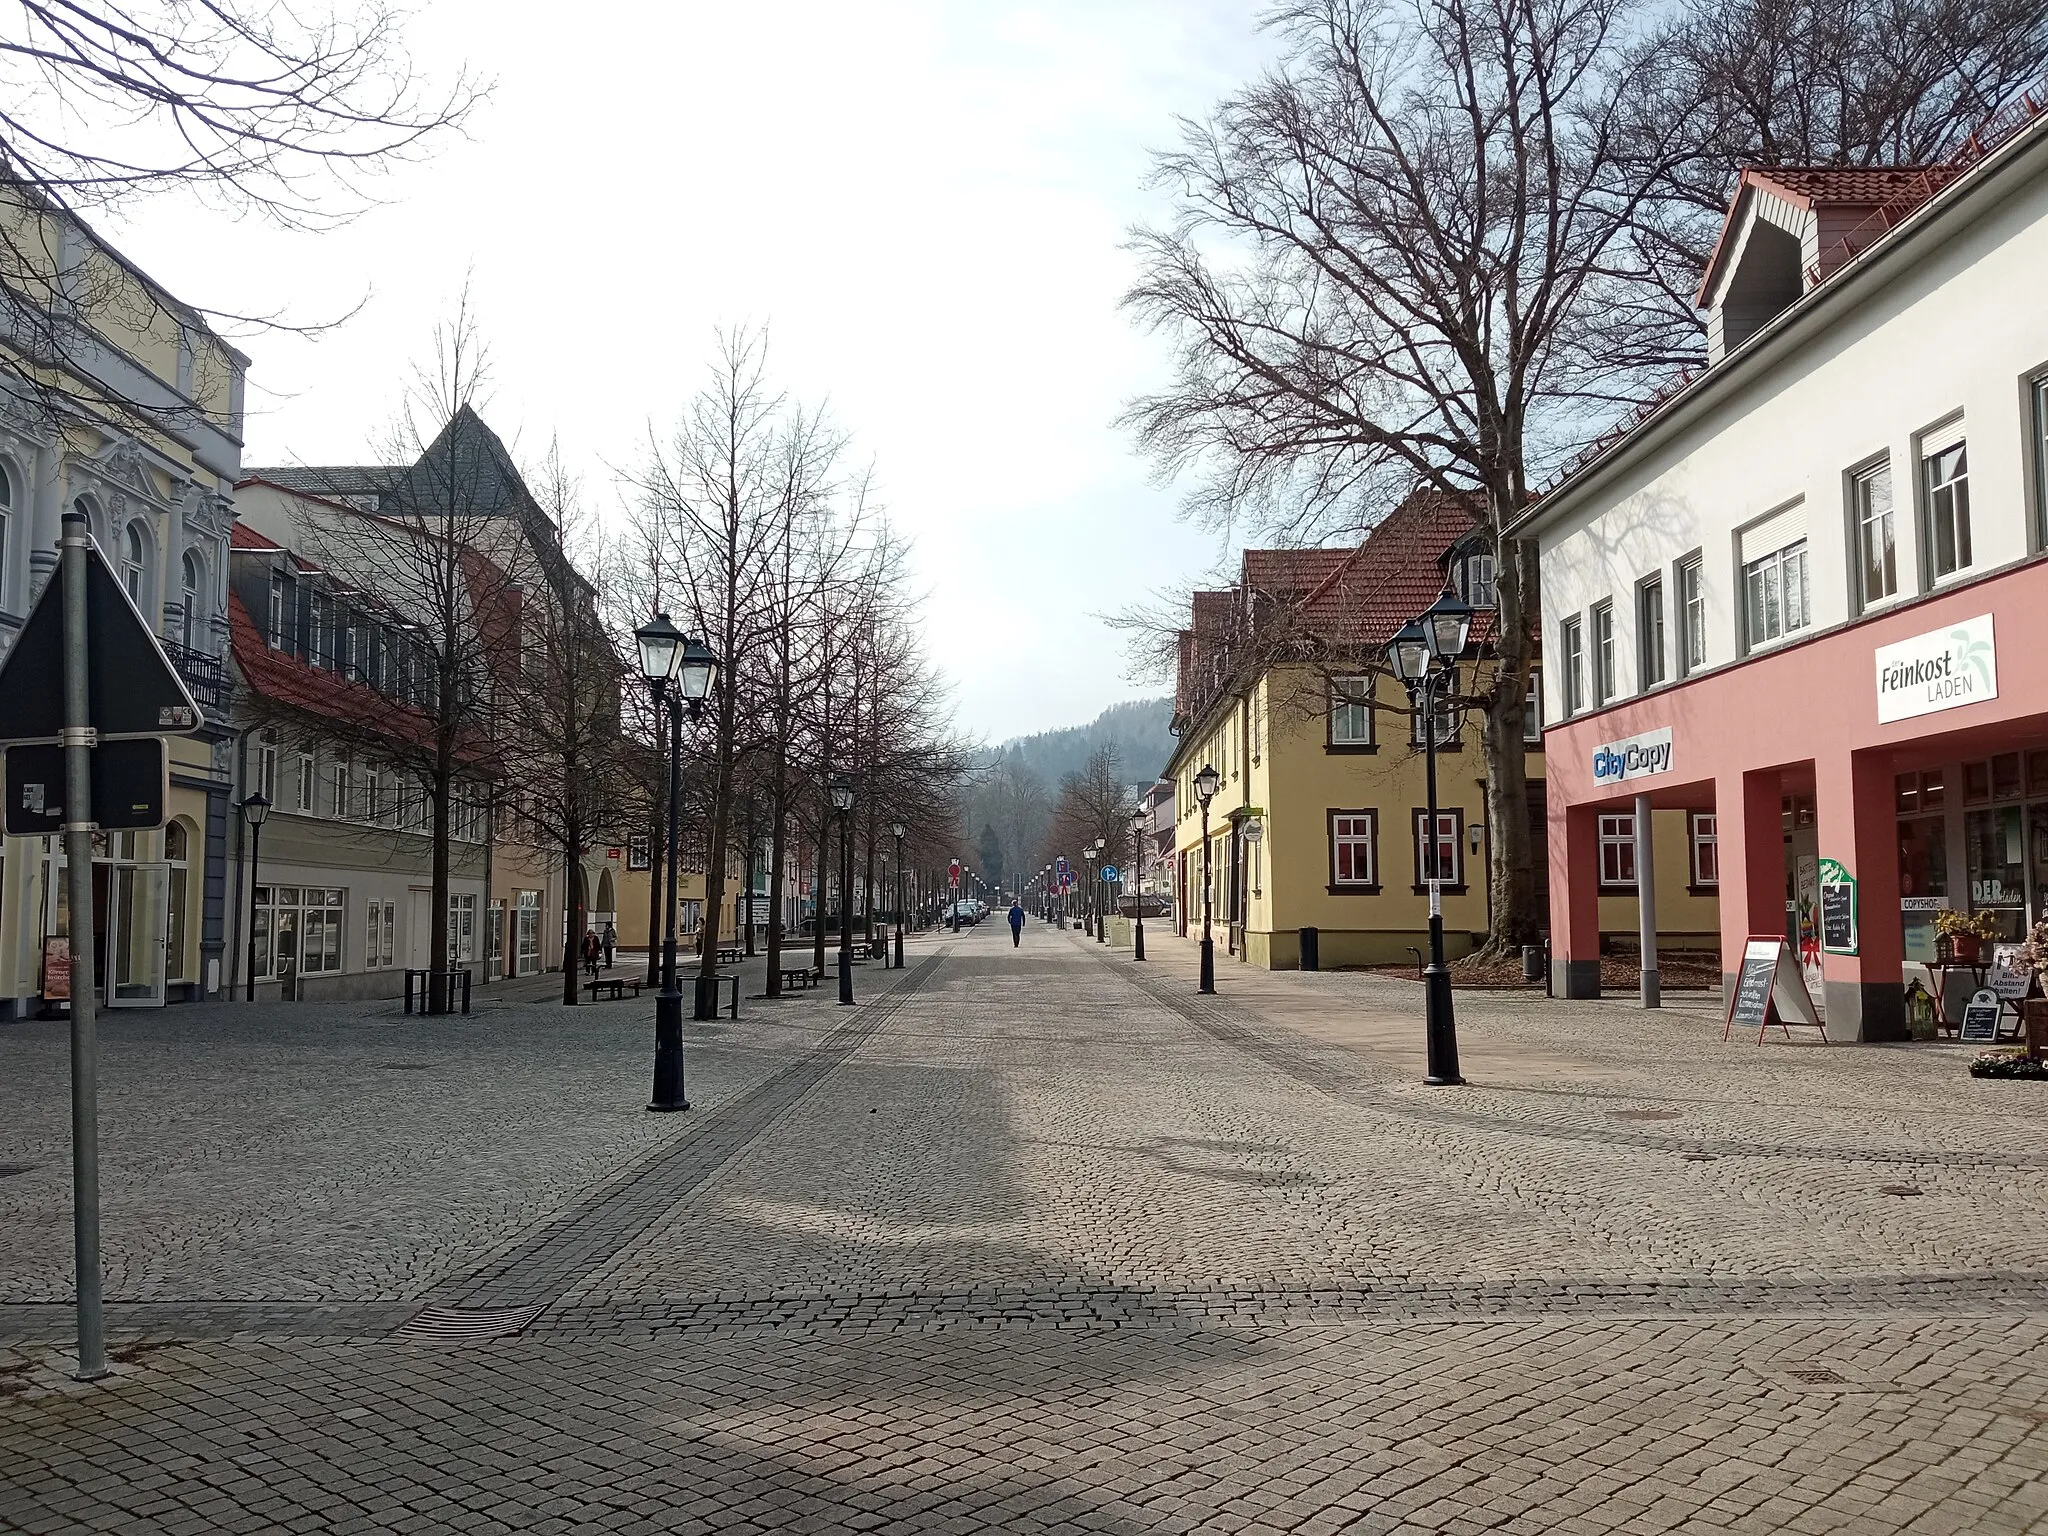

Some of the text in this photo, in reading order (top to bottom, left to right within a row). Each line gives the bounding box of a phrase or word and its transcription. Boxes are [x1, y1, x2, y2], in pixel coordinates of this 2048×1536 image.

[1882, 650, 1952, 693] Feinkost
[1928, 673, 1972, 702] LADEN
[1593, 742, 1671, 780] CityCopy
[1972, 880, 2002, 901] DER
